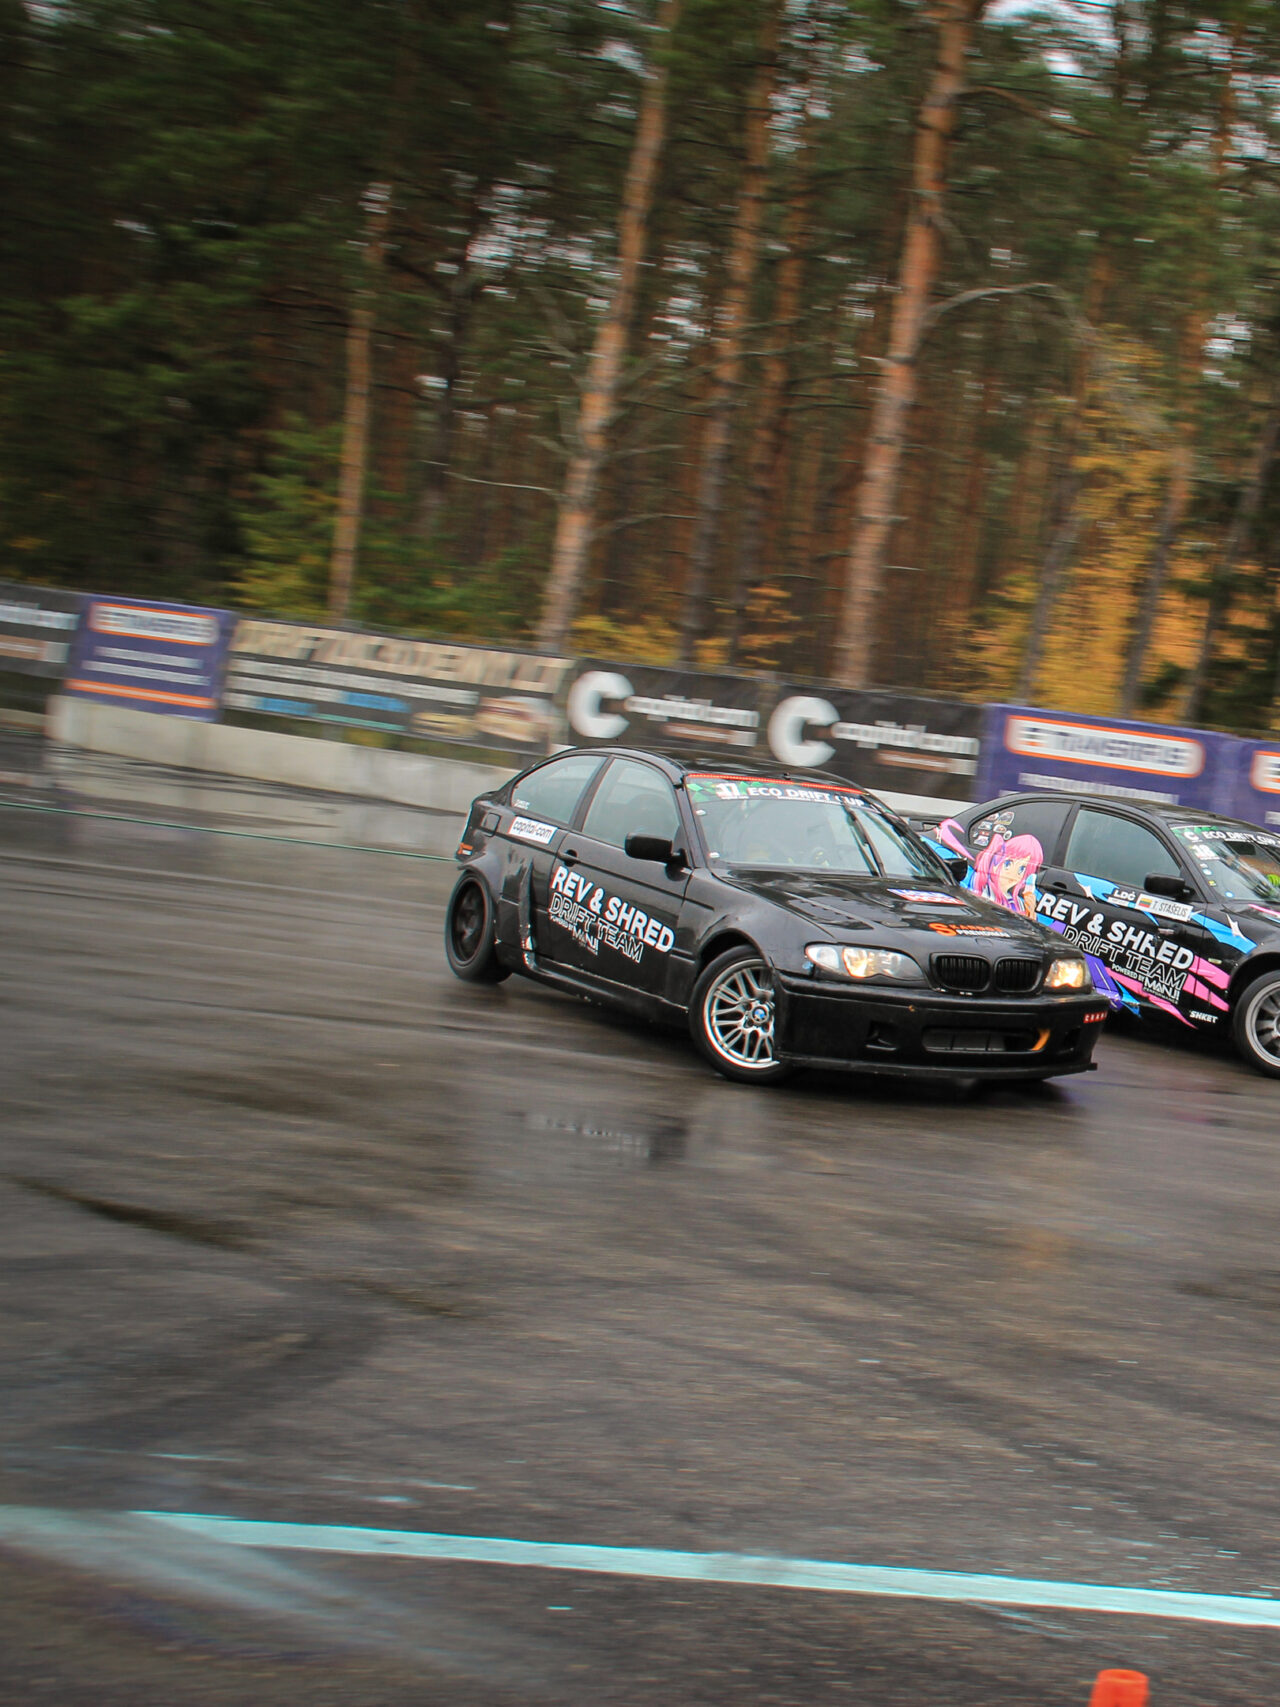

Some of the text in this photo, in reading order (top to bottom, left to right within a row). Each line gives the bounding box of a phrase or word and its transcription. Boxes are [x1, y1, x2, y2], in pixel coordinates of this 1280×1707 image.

[747, 787, 783, 797] ECO
[785, 789, 831, 801] DRIFT
[549, 892, 597, 933] DRIFT
[597, 918, 644, 964] TEAM
[550, 866, 594, 903] REV
[589, 888, 605, 914] &
[605, 896, 675, 952] SHRED
[1036, 893, 1195, 970] REV & SHRED
[1063, 927, 1189, 991] DRIFT TEAM
[1112, 963, 1138, 979] POWERED
